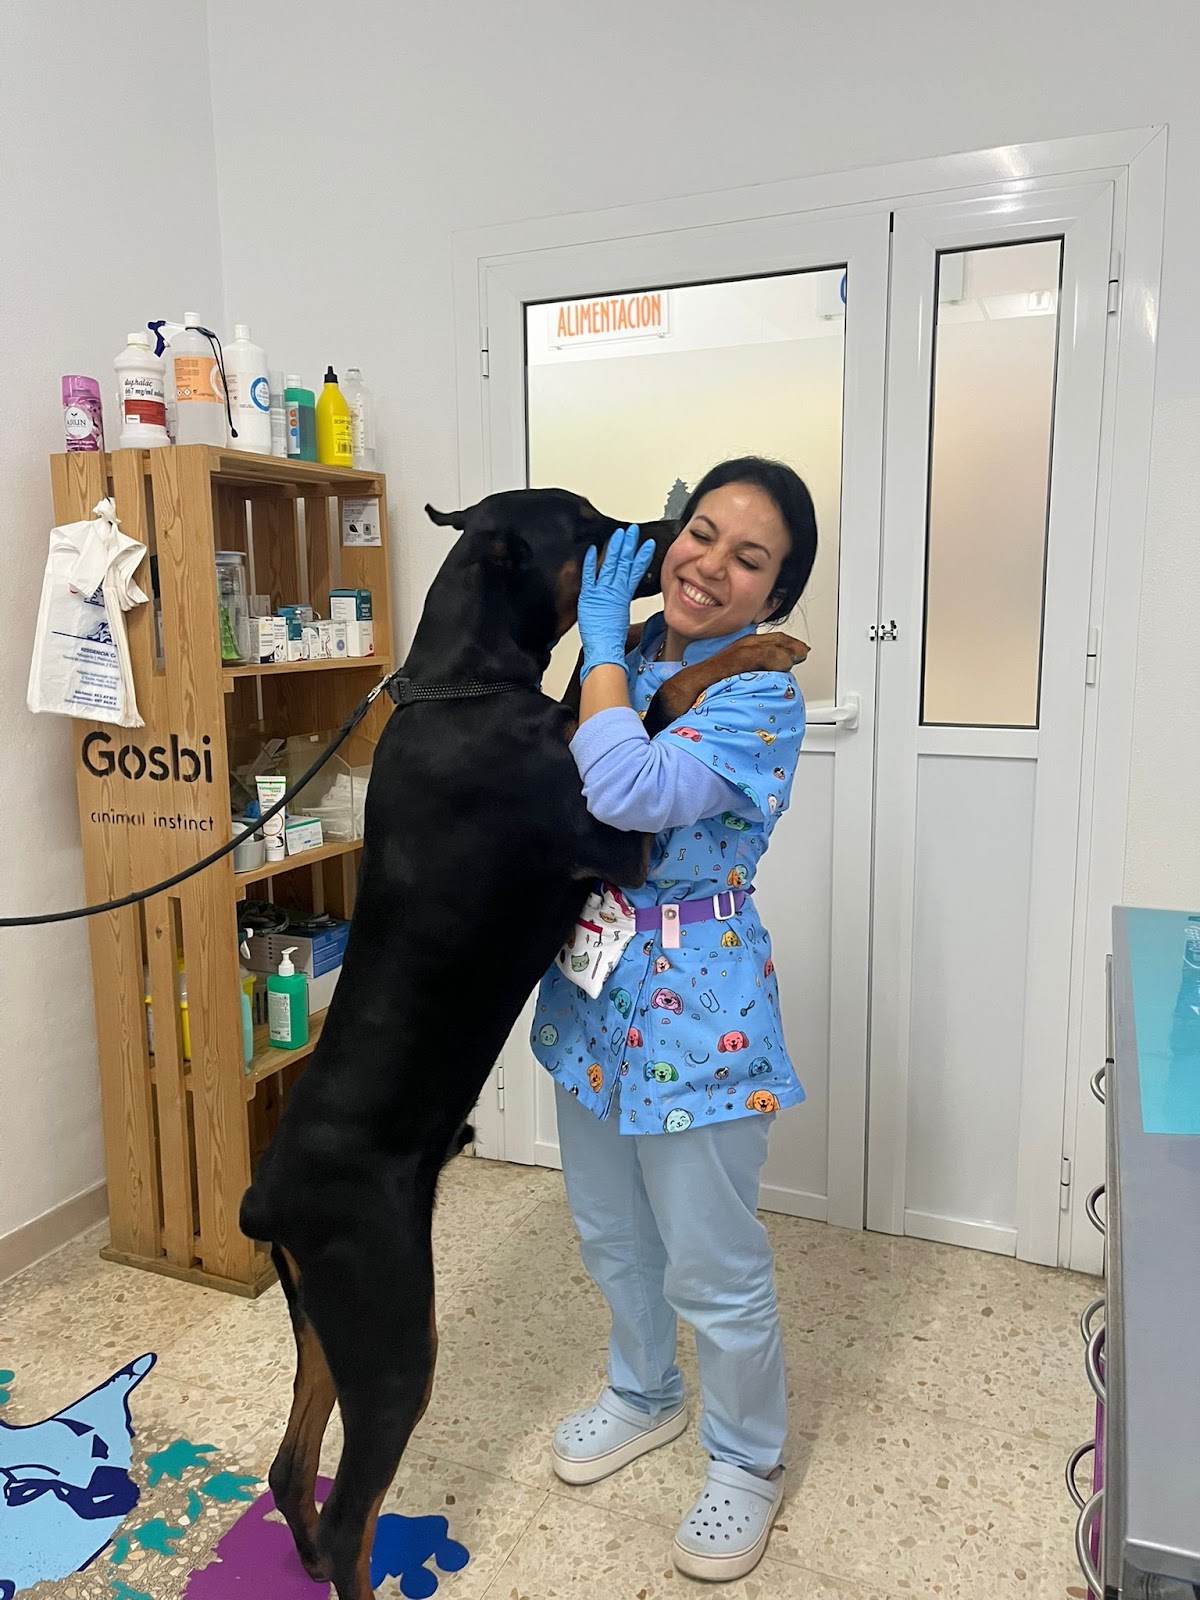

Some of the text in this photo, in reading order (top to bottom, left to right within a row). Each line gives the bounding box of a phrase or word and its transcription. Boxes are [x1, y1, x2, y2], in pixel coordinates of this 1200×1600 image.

[557, 293, 661, 338] ALIMENTACION
[82, 731, 213, 783] Gosbi
[91, 808, 214, 832] animal instinct
